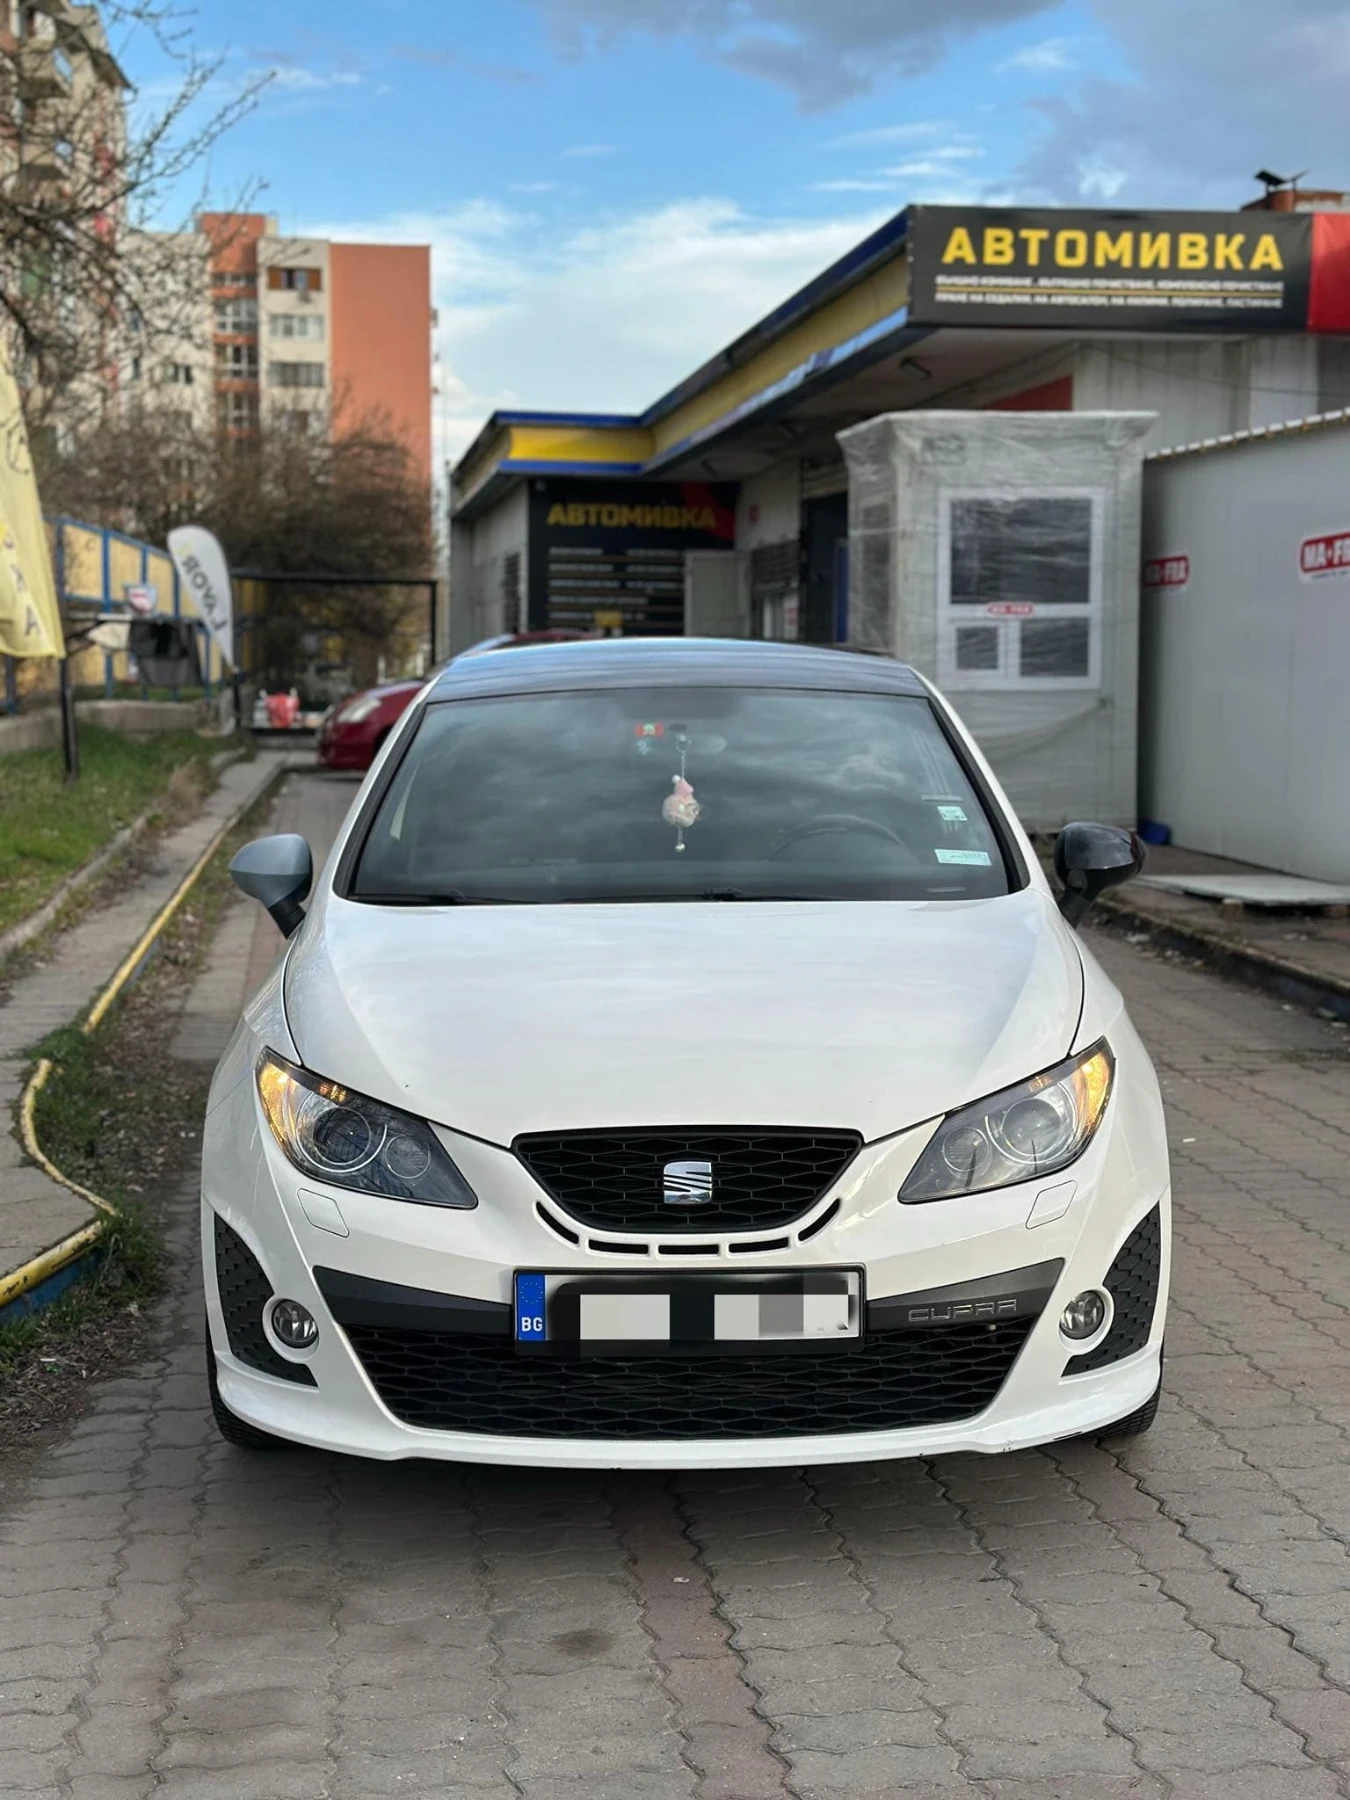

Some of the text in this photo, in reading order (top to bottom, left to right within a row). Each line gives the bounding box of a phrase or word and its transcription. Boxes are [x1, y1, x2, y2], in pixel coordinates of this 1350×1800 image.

[941, 226, 1284, 271] АВТОМИВКА
[547, 503, 716, 528] АВТОМИВКА
[908, 1299, 1017, 1321] CUPRA
[521, 1316, 543, 1332] BG
